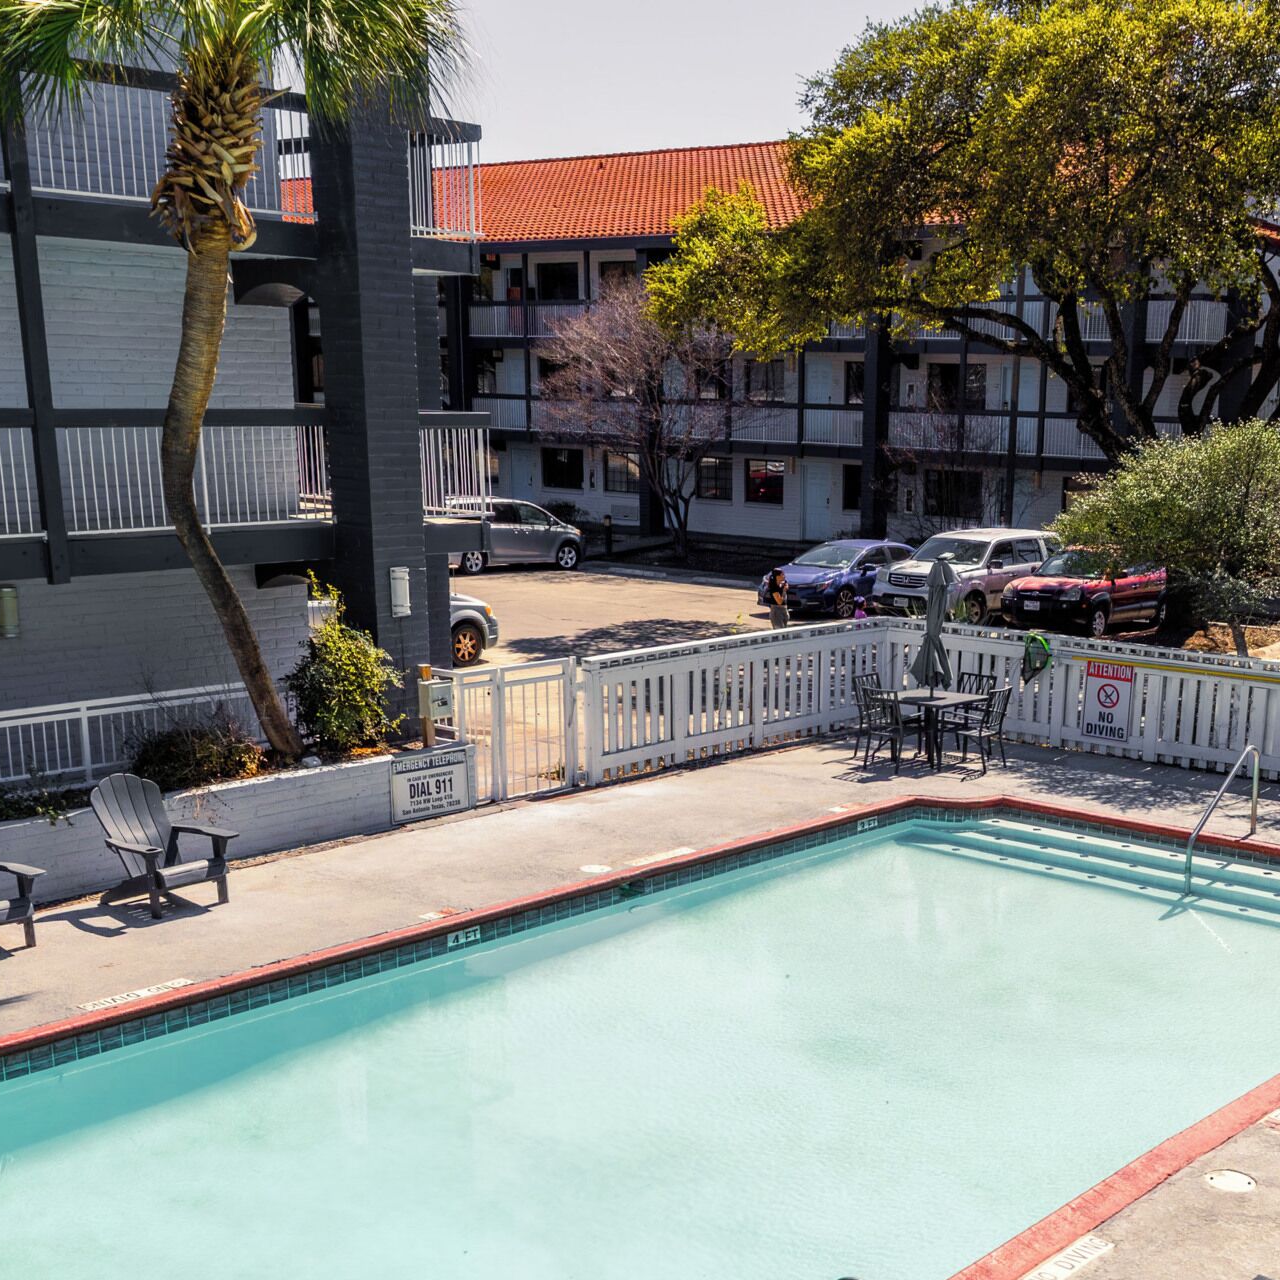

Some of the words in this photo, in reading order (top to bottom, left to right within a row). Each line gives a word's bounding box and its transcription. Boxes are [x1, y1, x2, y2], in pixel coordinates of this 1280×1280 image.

[1089, 662, 1131, 679] ATTENTION
[1098, 711, 1114, 724] NO
[1086, 722, 1124, 739] DIVING
[392, 760, 430, 772] EMERGENCY
[432, 752, 466, 765] TELEPHONE
[409, 781, 432, 799] DIAL
[435, 777, 453, 794] 911
[452, 934, 459, 944] 4
[464, 928, 478, 940] FT
[1054, 1237, 1109, 1270] DIVING
